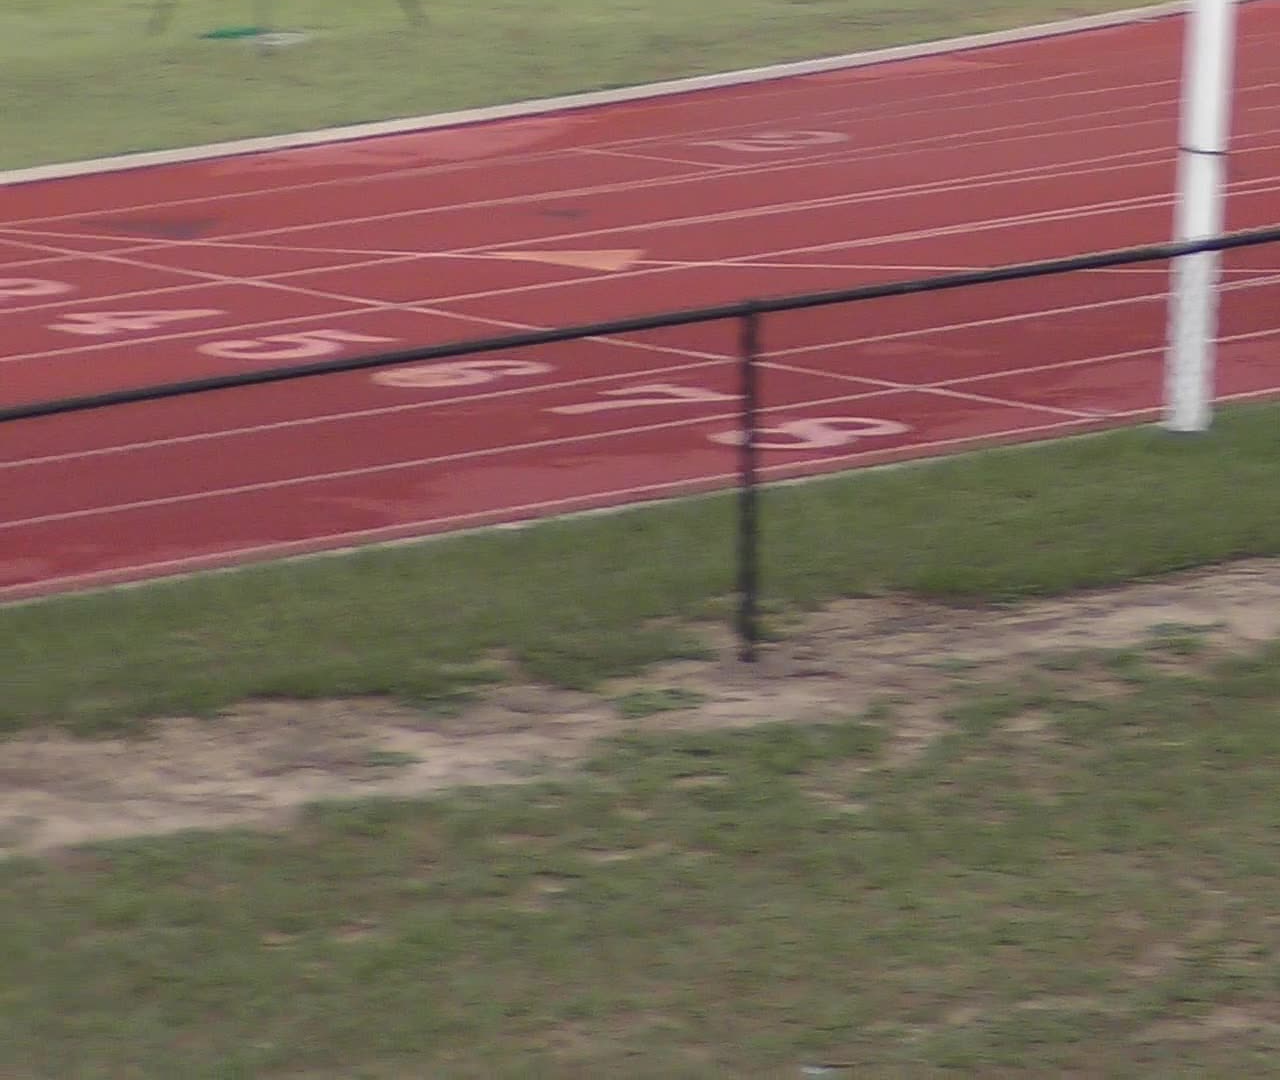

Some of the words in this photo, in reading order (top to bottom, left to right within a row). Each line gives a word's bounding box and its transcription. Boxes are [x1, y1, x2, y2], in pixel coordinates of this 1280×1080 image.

[47, 308, 228, 336] 4
[196, 329, 398, 360] 5
[369, 359, 557, 388] 6
[541, 383, 750, 415] 7
[707, 416, 911, 449] 8
